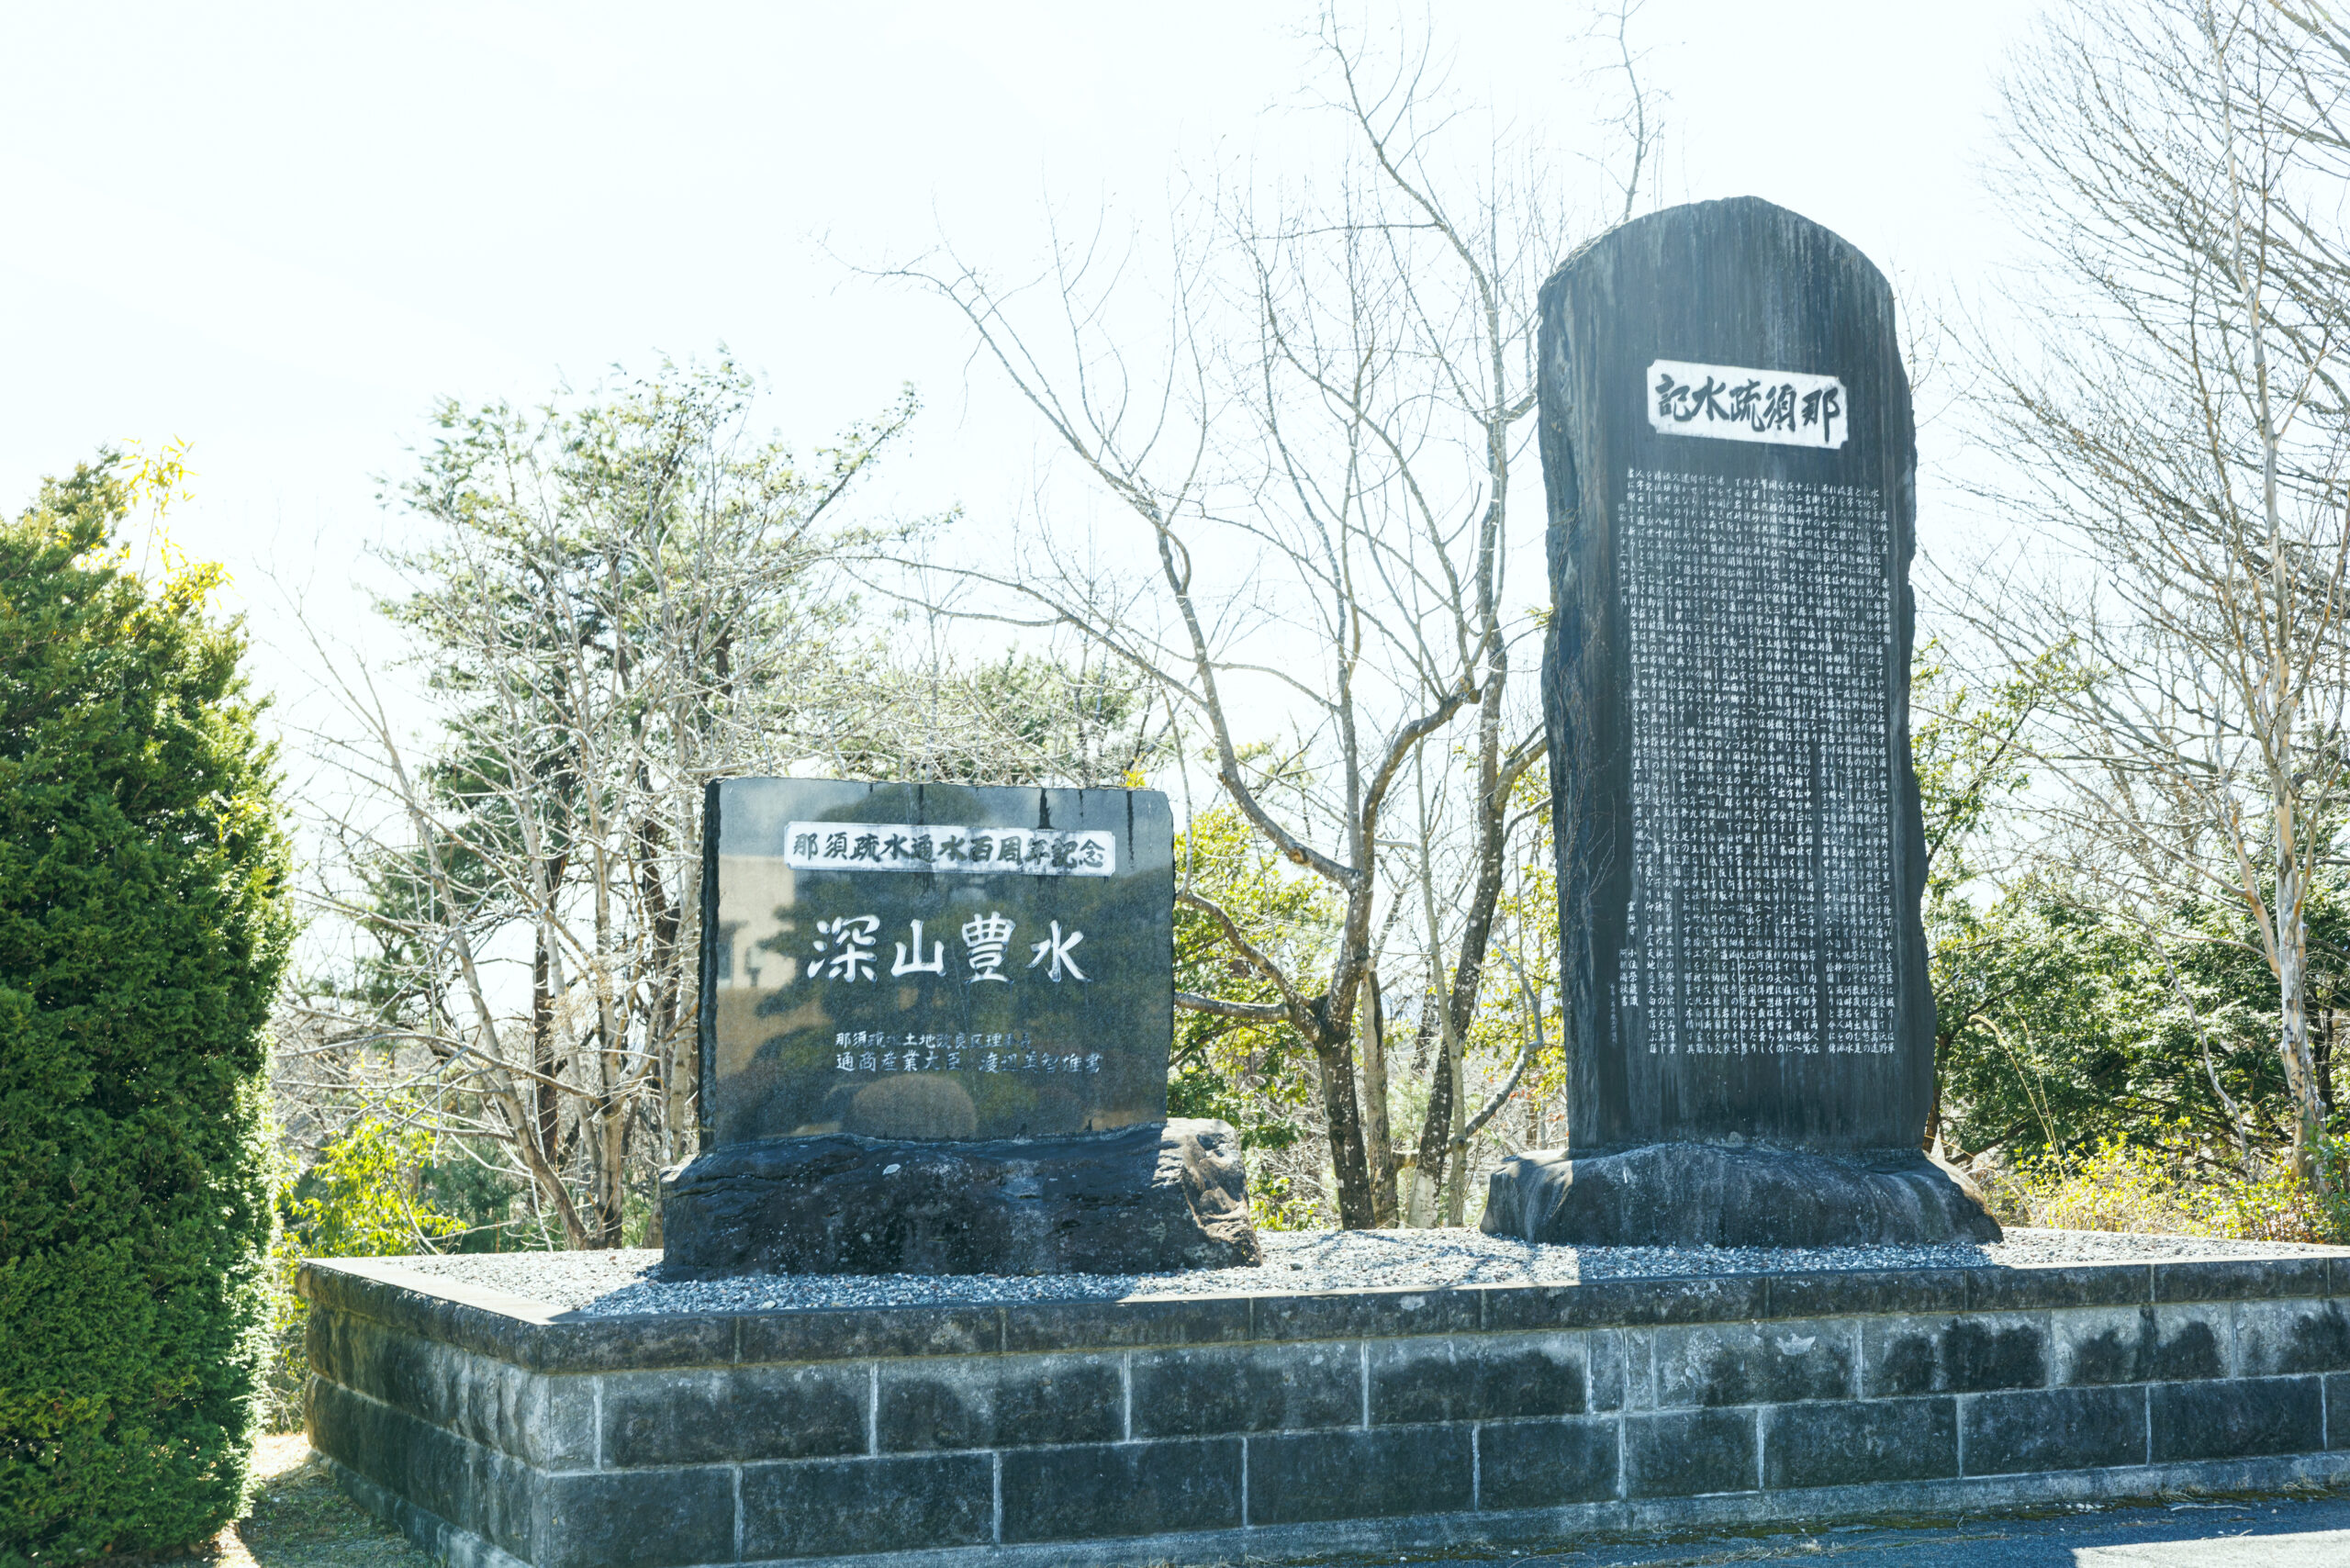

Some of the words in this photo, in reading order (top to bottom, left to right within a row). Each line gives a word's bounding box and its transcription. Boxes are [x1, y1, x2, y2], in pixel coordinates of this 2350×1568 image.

[1655, 374, 1841, 442] 那須疏水記
[793, 832, 1105, 868] 那須疏水通水百周年記念
[807, 911, 1092, 982] 深山豊水
[835, 1051, 964, 1072] 通商産業大臣
